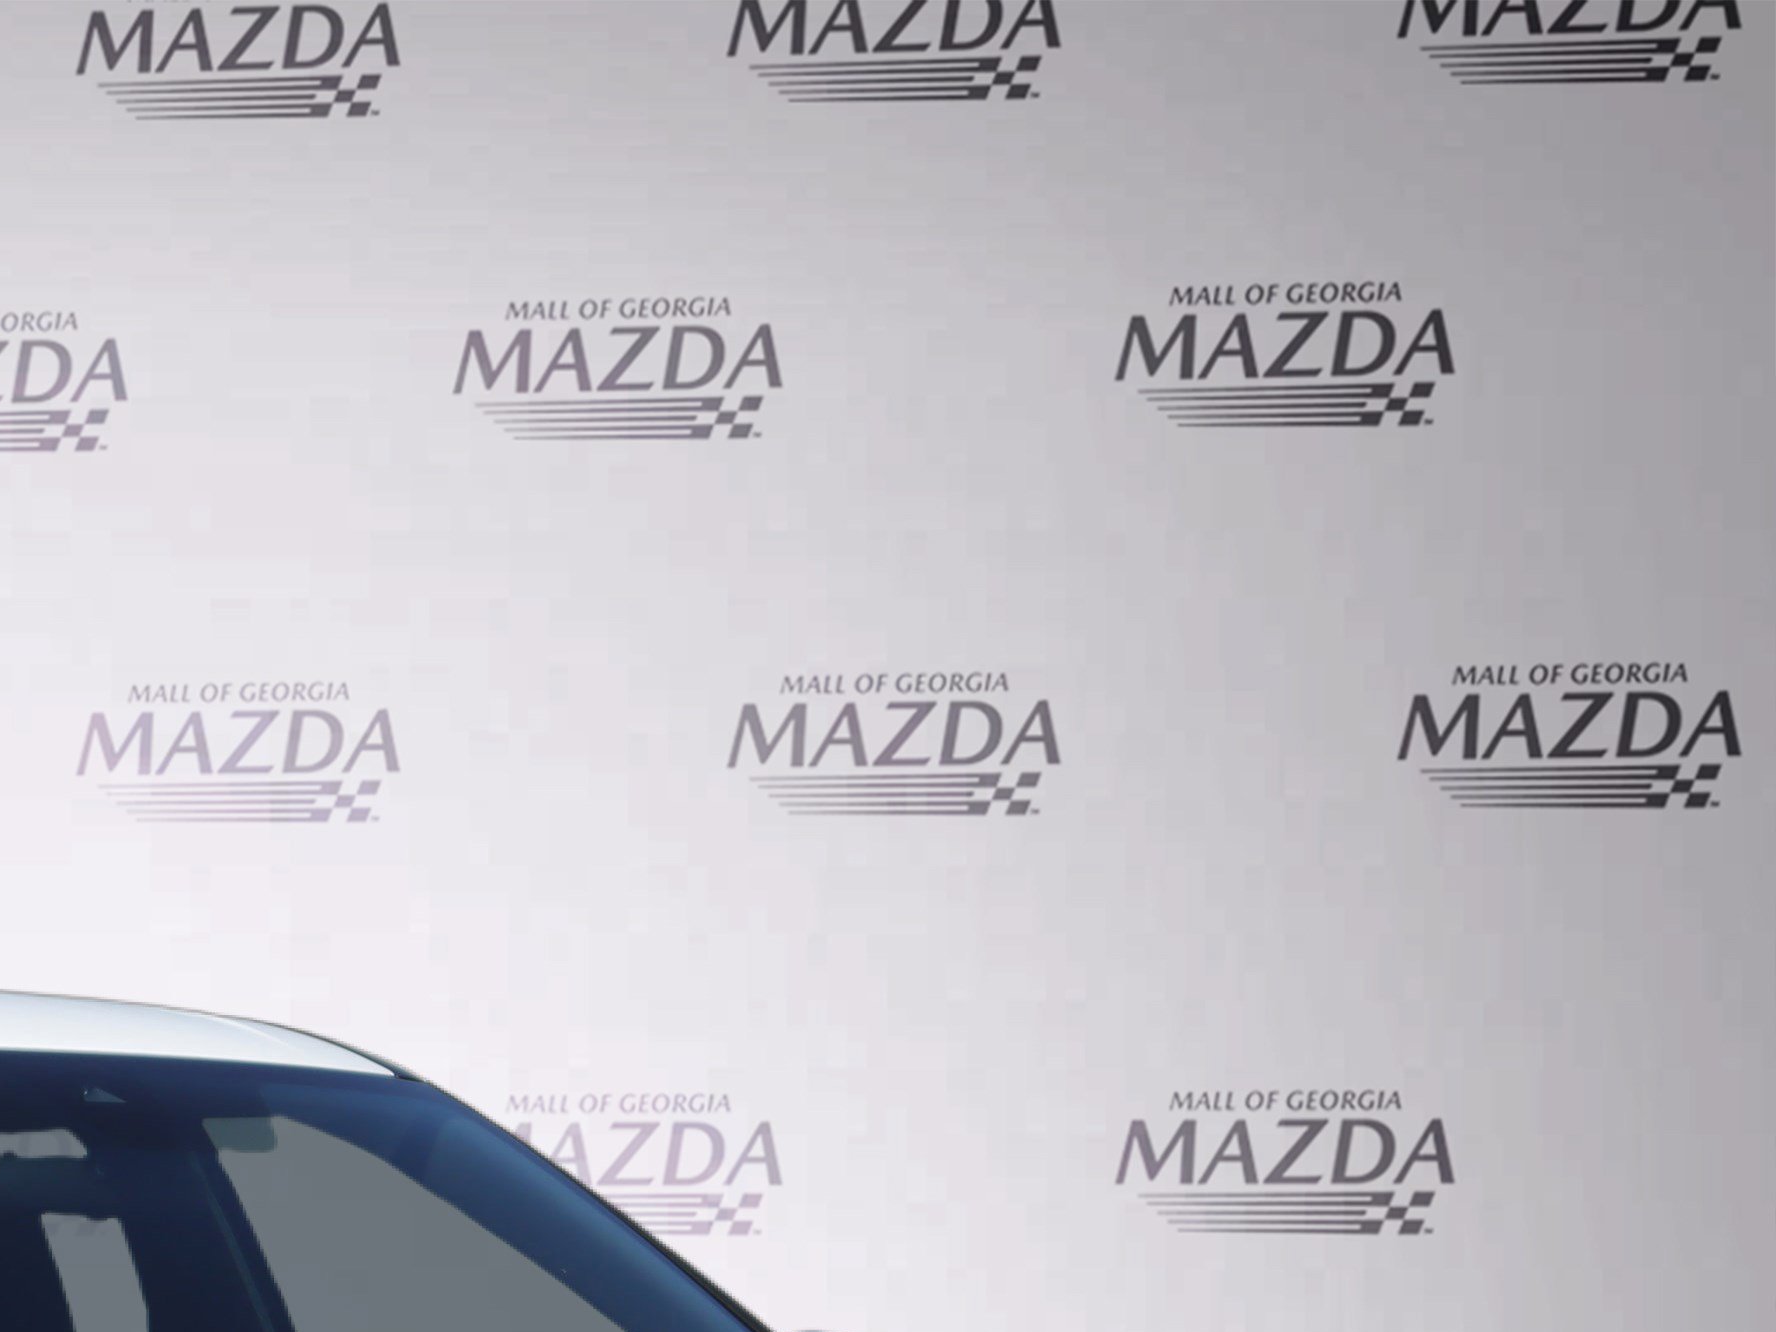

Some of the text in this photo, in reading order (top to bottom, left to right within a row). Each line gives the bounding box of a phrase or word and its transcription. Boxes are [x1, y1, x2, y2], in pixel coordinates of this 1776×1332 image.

[75, 2, 401, 76] MAZDA
[726, 0, 1062, 58] MAZDA
[506, 297, 731, 320] MALL OF GEORGIA
[1169, 282, 1402, 306] MALL OF GEORGIA
[452, 324, 783, 395] MAZDA
[1114, 309, 1456, 382] MAZDA
[127, 682, 350, 704] MALL OF GEORGIA
[780, 672, 1009, 695] MALL OF GEORGIA
[1452, 663, 1688, 686] MALL OF GEORGIA
[76, 708, 401, 777] MAZDA
[726, 700, 1061, 769] MAZDA
[1397, 690, 1742, 761] MAZDA
[505, 1093, 732, 1114] MALL OF GEORGIA
[1169, 1090, 1402, 1112] MALL OF GEORGIA
[509, 1120, 783, 1187] AZDA
[1115, 1117, 1455, 1185] MAZDA
